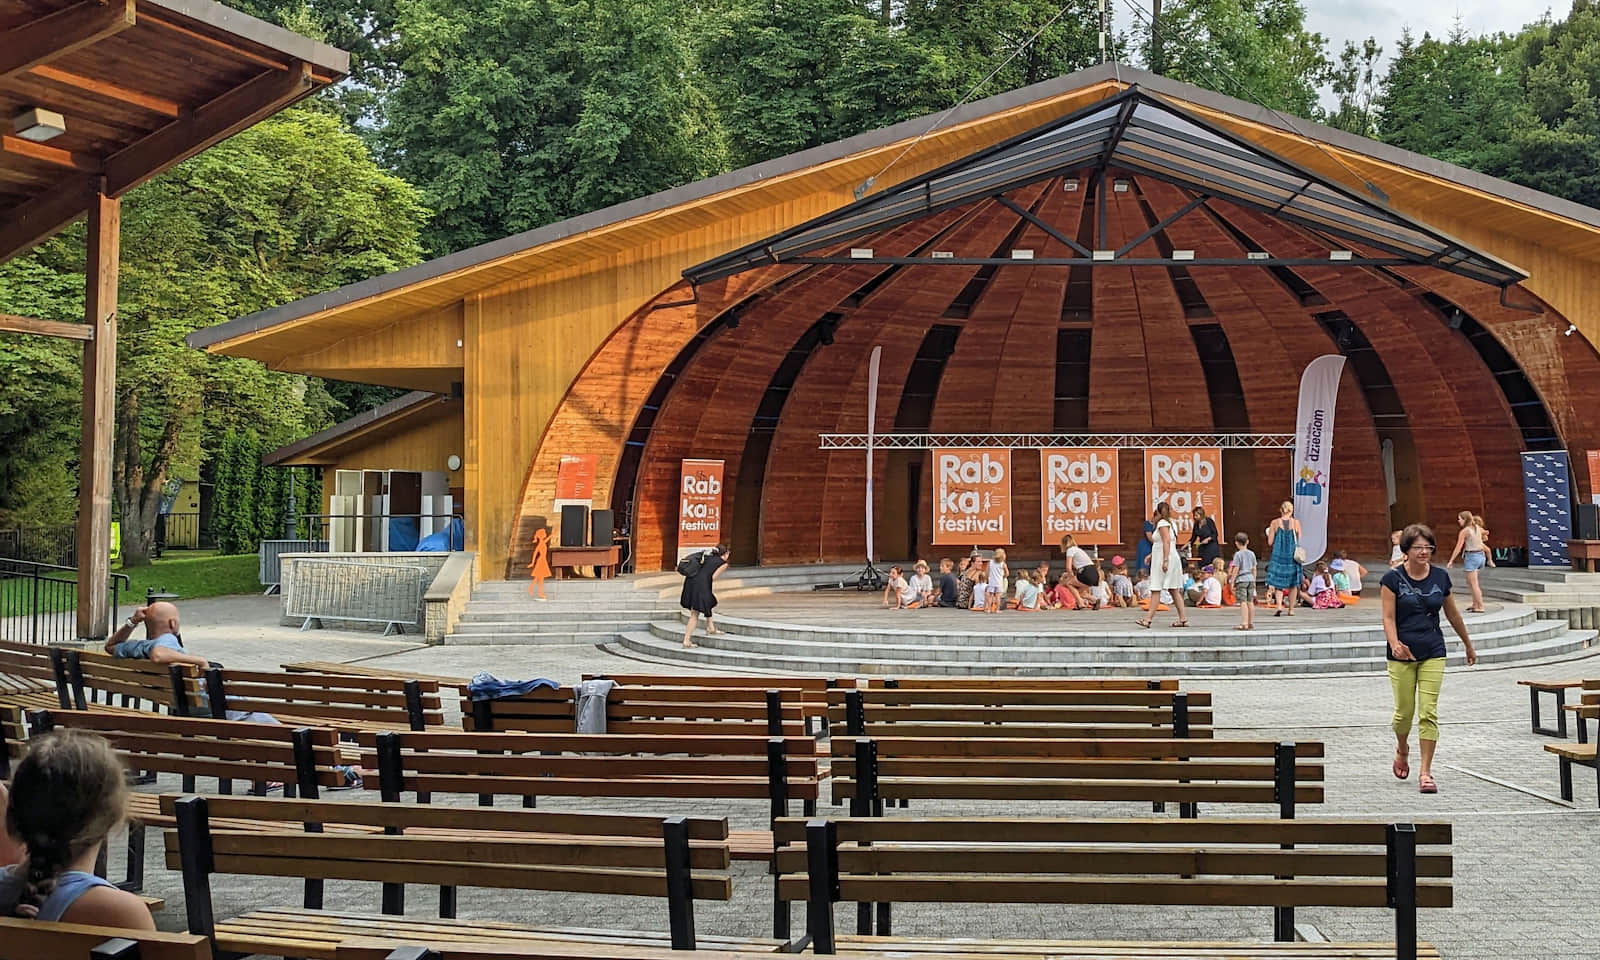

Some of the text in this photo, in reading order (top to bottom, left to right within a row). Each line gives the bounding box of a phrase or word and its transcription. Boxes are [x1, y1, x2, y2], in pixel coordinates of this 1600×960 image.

[1309, 409, 1325, 462] dzieciom
[940, 453, 1004, 484] Rab
[1048, 453, 1111, 484] Rab
[1152, 452, 1215, 483] Rab
[683, 474, 720, 494] Rab
[940, 482, 980, 514] ka
[1048, 482, 1088, 514] ka
[1152, 482, 1191, 513] ka
[682, 498, 707, 518] ka
[938, 515, 1004, 532] festival
[1047, 514, 1111, 532] festival
[681, 519, 719, 531] festival
